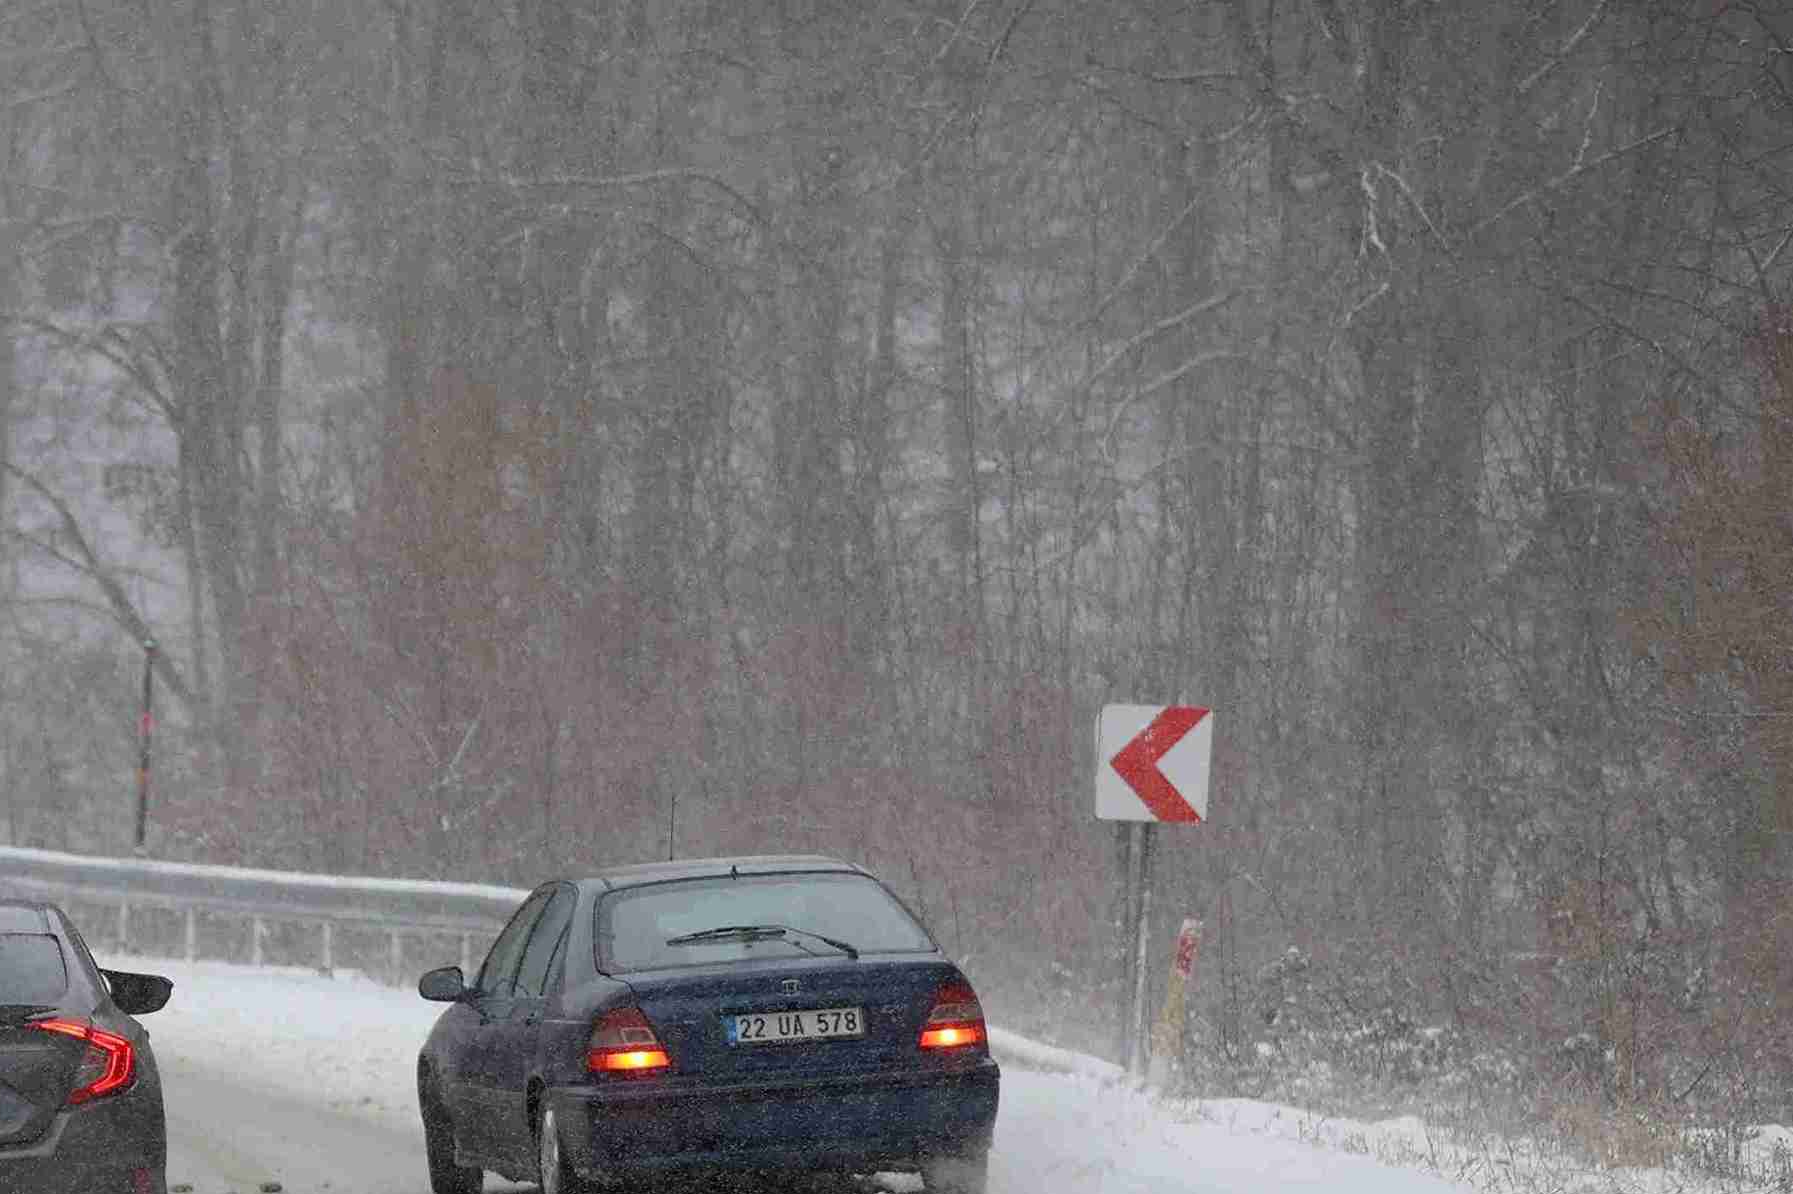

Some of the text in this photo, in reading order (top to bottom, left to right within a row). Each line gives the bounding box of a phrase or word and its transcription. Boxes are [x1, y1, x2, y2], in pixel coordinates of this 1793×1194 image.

[739, 1011, 857, 1039] 22 UA 578
